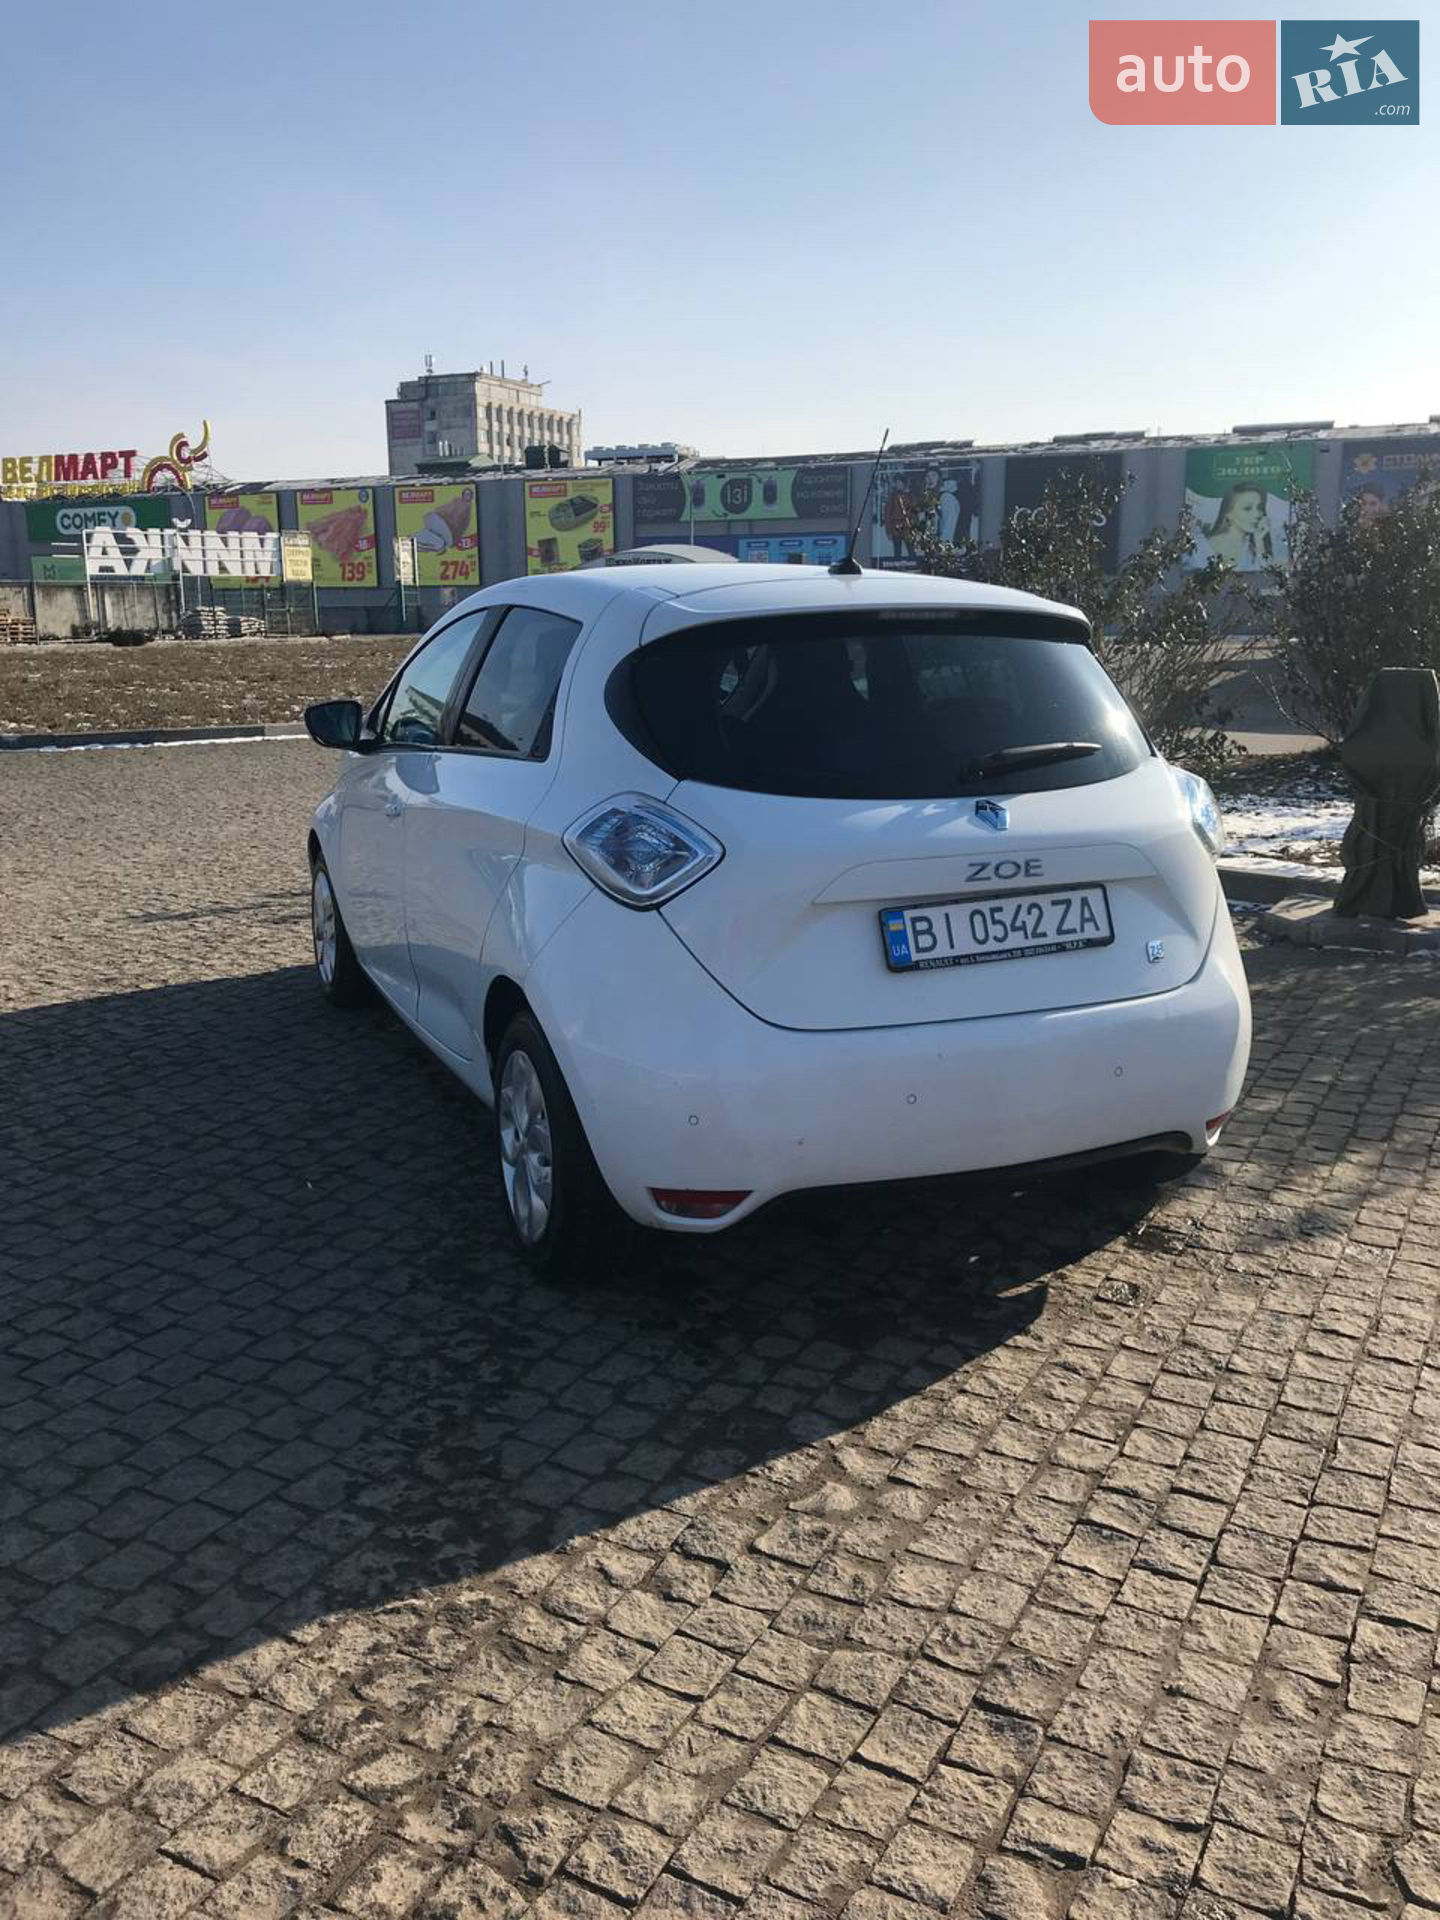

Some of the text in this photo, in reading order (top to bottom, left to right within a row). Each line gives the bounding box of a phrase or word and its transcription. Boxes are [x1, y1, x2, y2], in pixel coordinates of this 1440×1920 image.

[1, 450, 137, 484] ВЕЛМАРТ
[59, 511, 120, 531] COMFY
[339, 562, 366, 582] 139
[440, 560, 470, 581] 274
[964, 859, 1045, 883] ZOE
[909, 896, 1101, 955] BI 0542 ZA
[892, 944, 909, 957] UA
[919, 957, 954, 969] RENAULT
